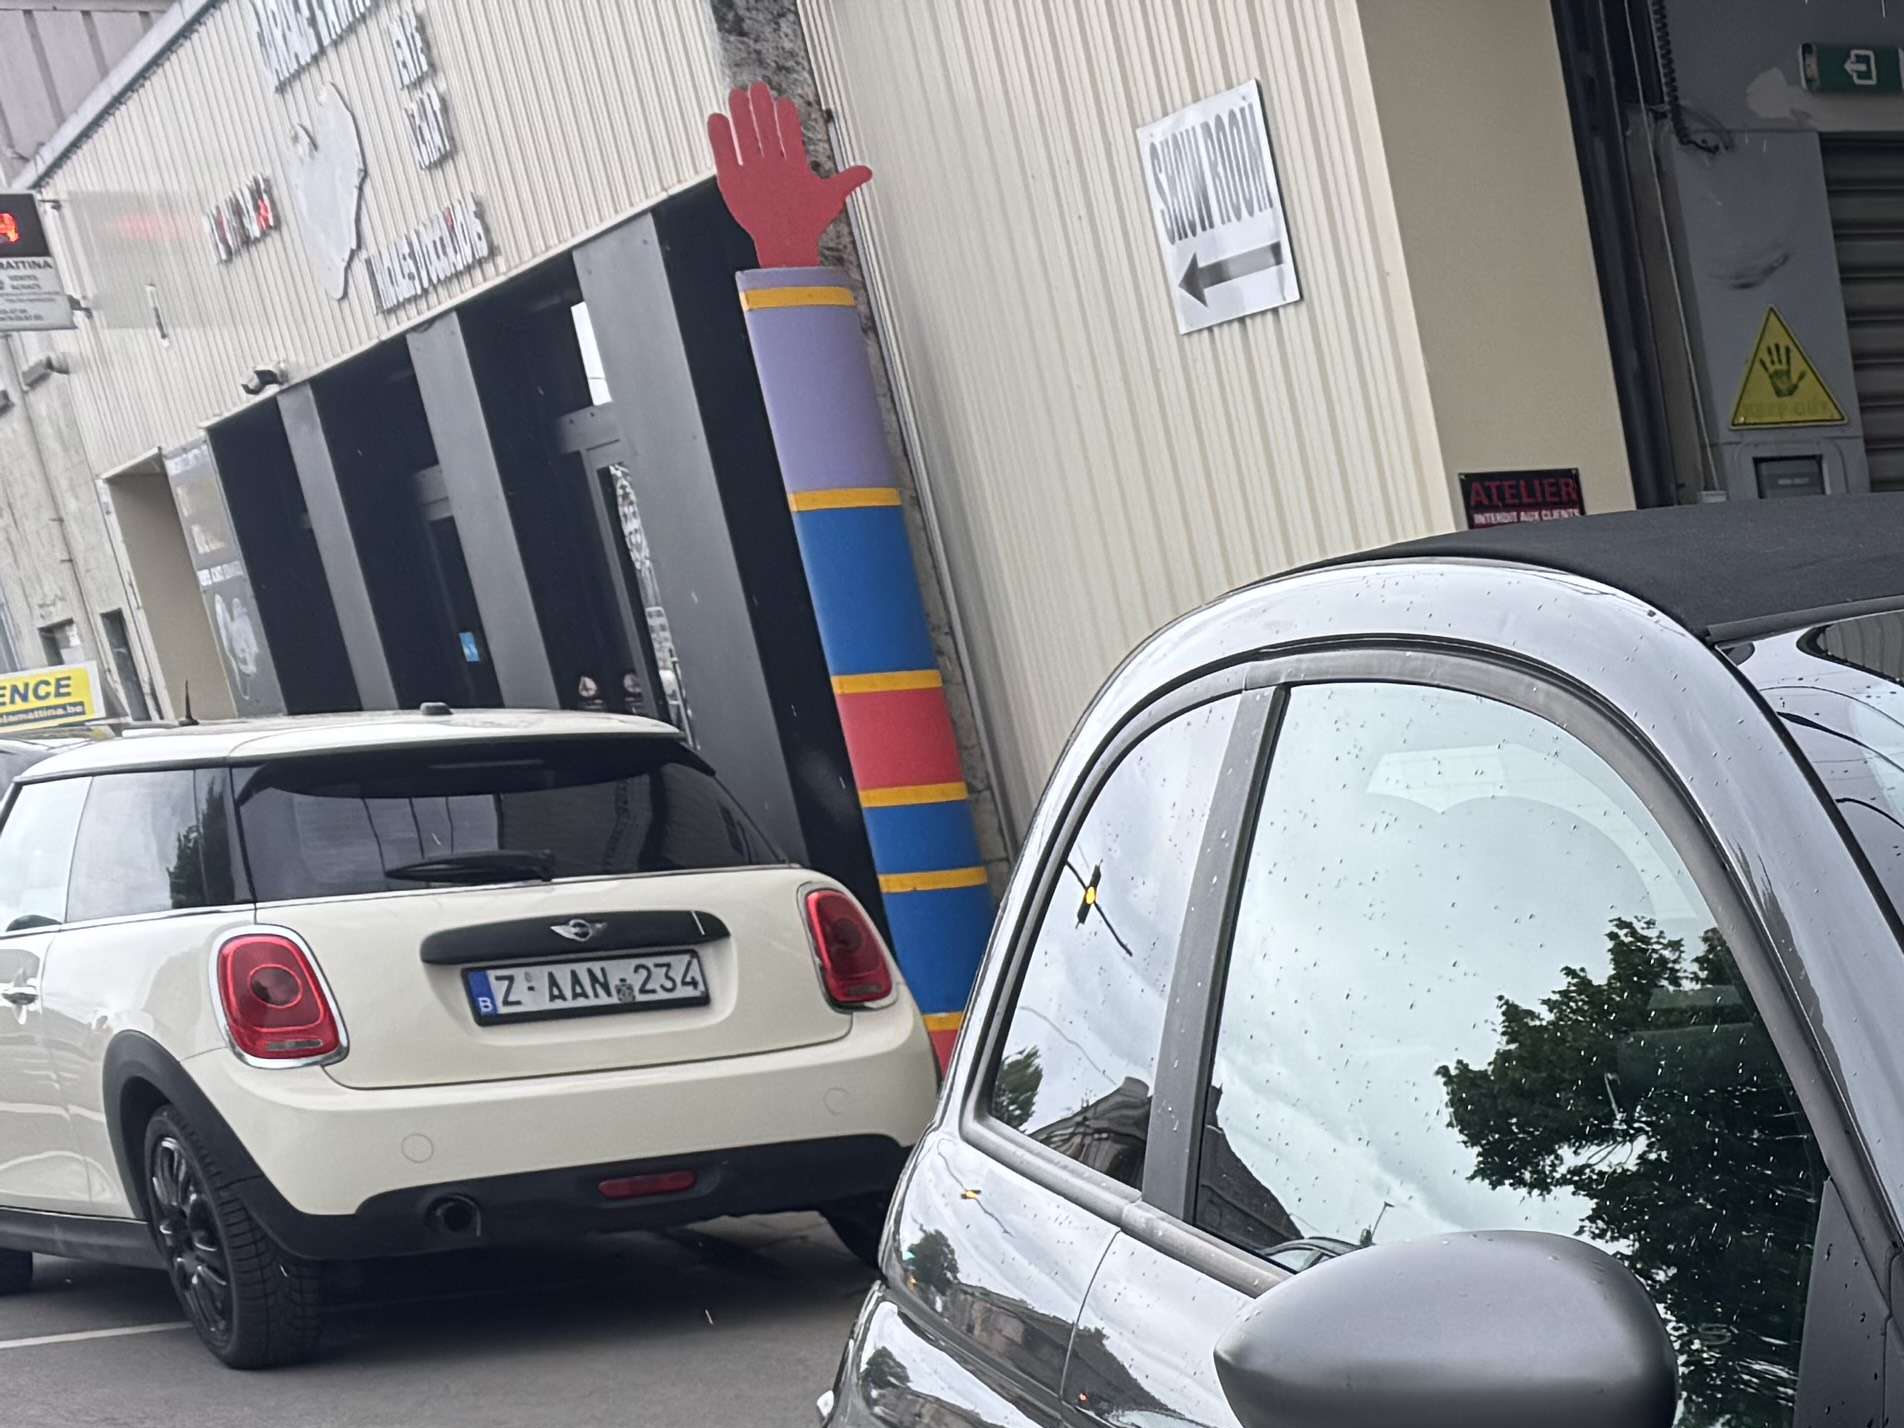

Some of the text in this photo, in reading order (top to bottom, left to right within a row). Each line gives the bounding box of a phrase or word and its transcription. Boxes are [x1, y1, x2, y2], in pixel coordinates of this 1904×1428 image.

[1149, 103, 1274, 246] SHOW ROOM
[1470, 479, 1579, 506] ATELIER
